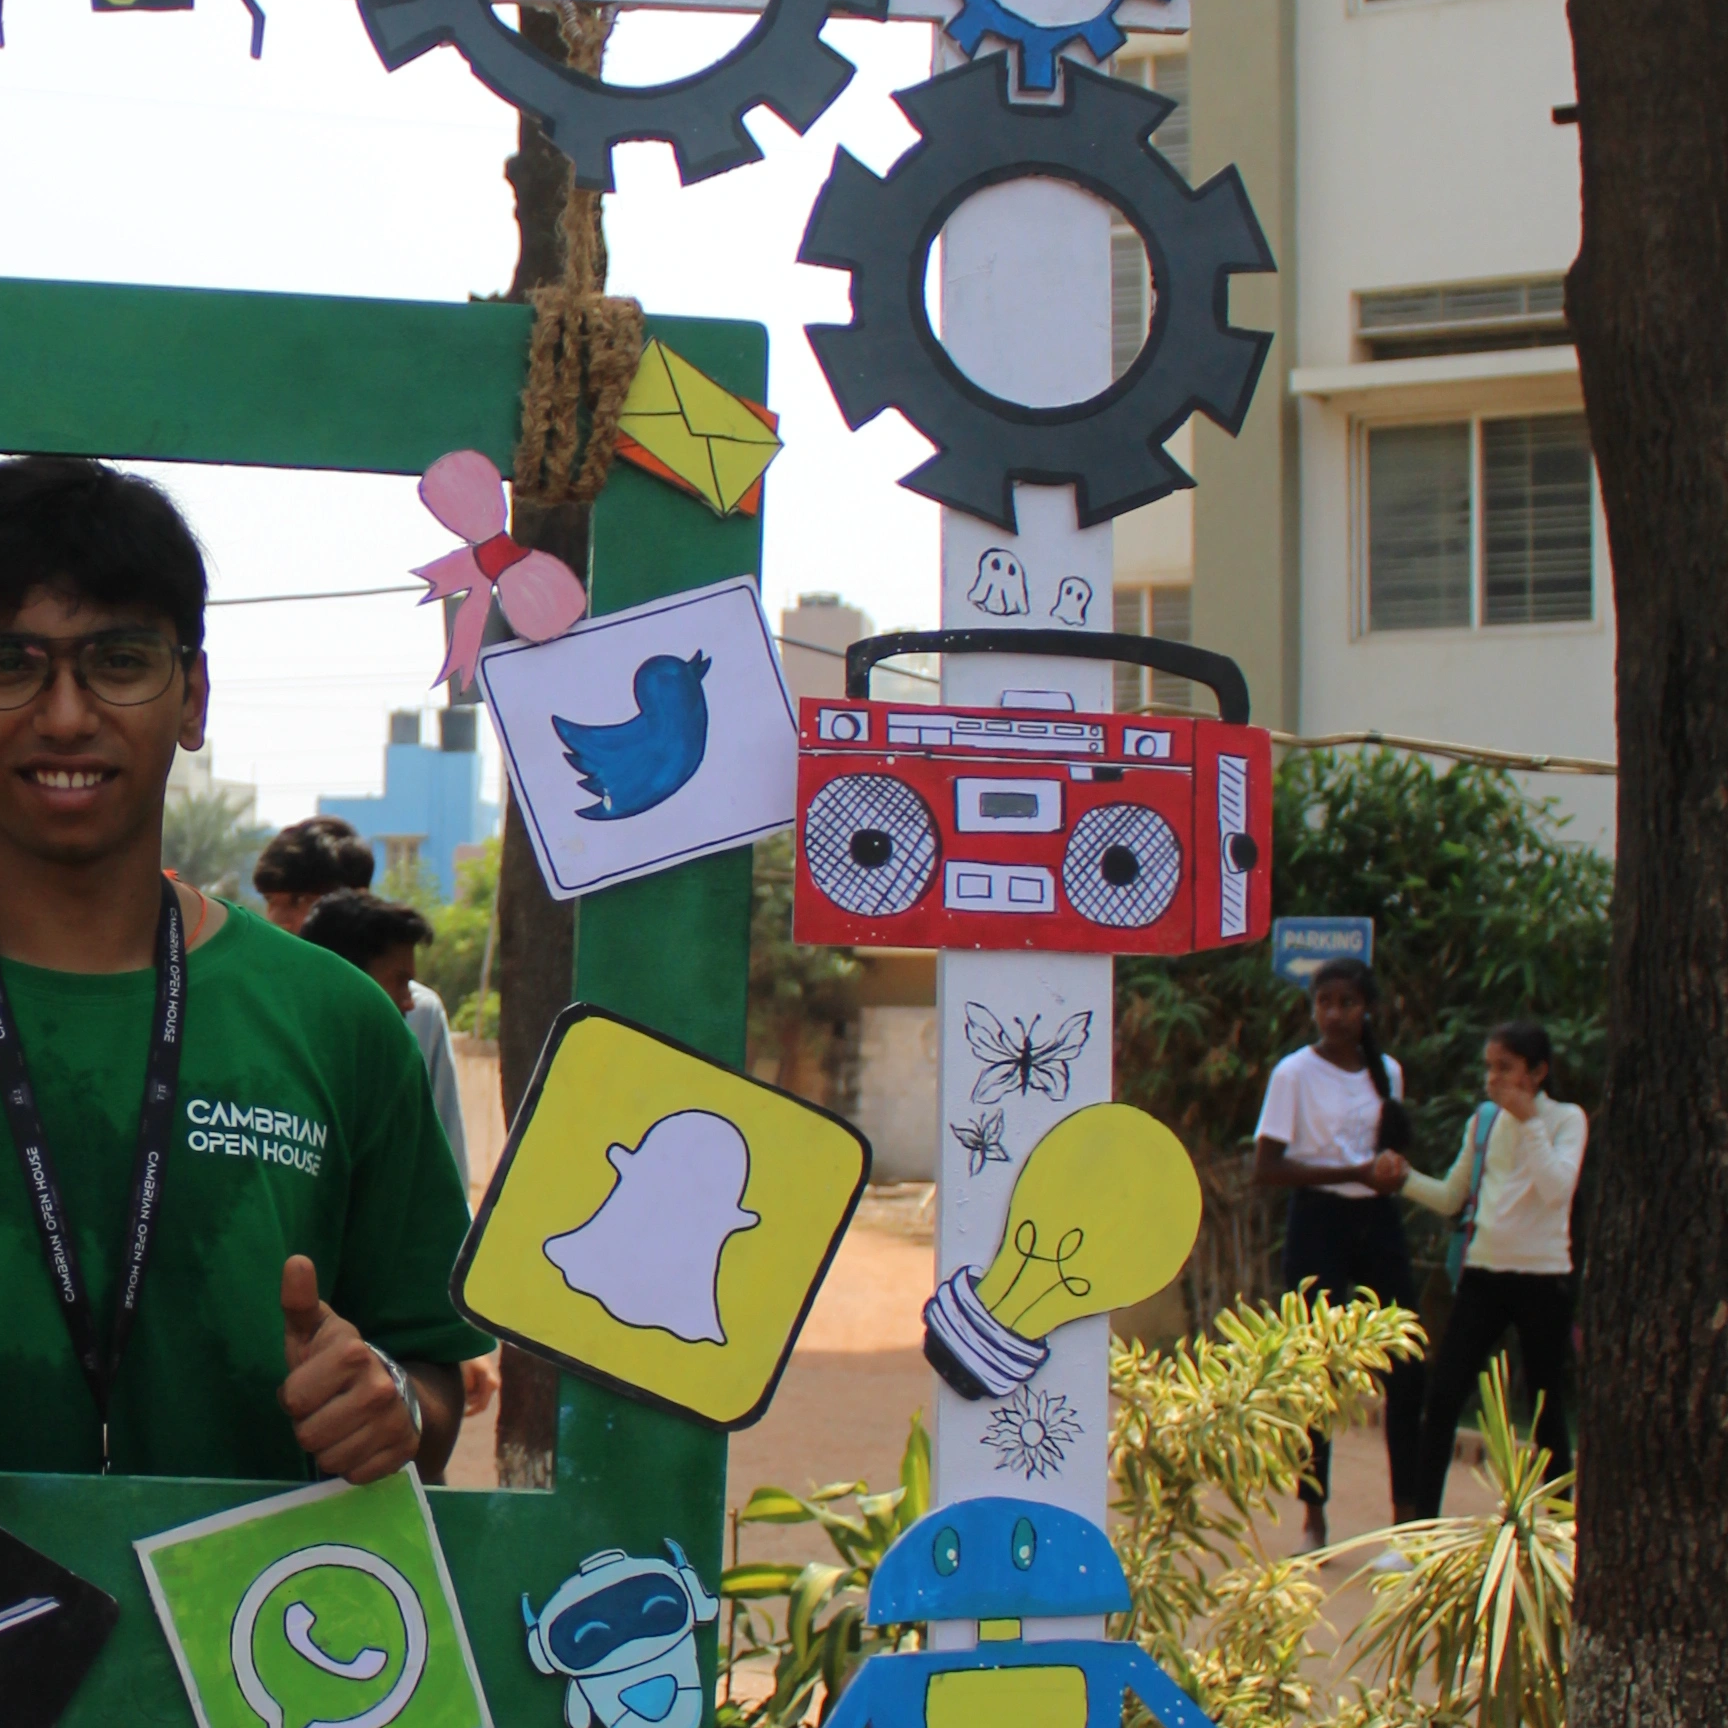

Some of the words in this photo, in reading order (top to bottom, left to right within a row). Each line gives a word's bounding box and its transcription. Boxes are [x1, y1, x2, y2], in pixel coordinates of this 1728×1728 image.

[1285, 929, 1364, 953] PARKING
[169, 964, 181, 998] OPEN
[163, 999, 179, 1043] HOUSE
[186, 1099, 328, 1149] CAMBRIAN
[26, 1145, 47, 1191] HOUSE
[187, 1130, 259, 1157] OPEN
[262, 1139, 322, 1177] HOUSE
[140, 1151, 159, 1220] CAMBRIAN
[38, 1193, 57, 1231] OPEN
[133, 1223, 148, 1261] OPEN
[49, 1234, 75, 1303] CAMBRIAN
[124, 1265, 140, 1309] HOUSE
